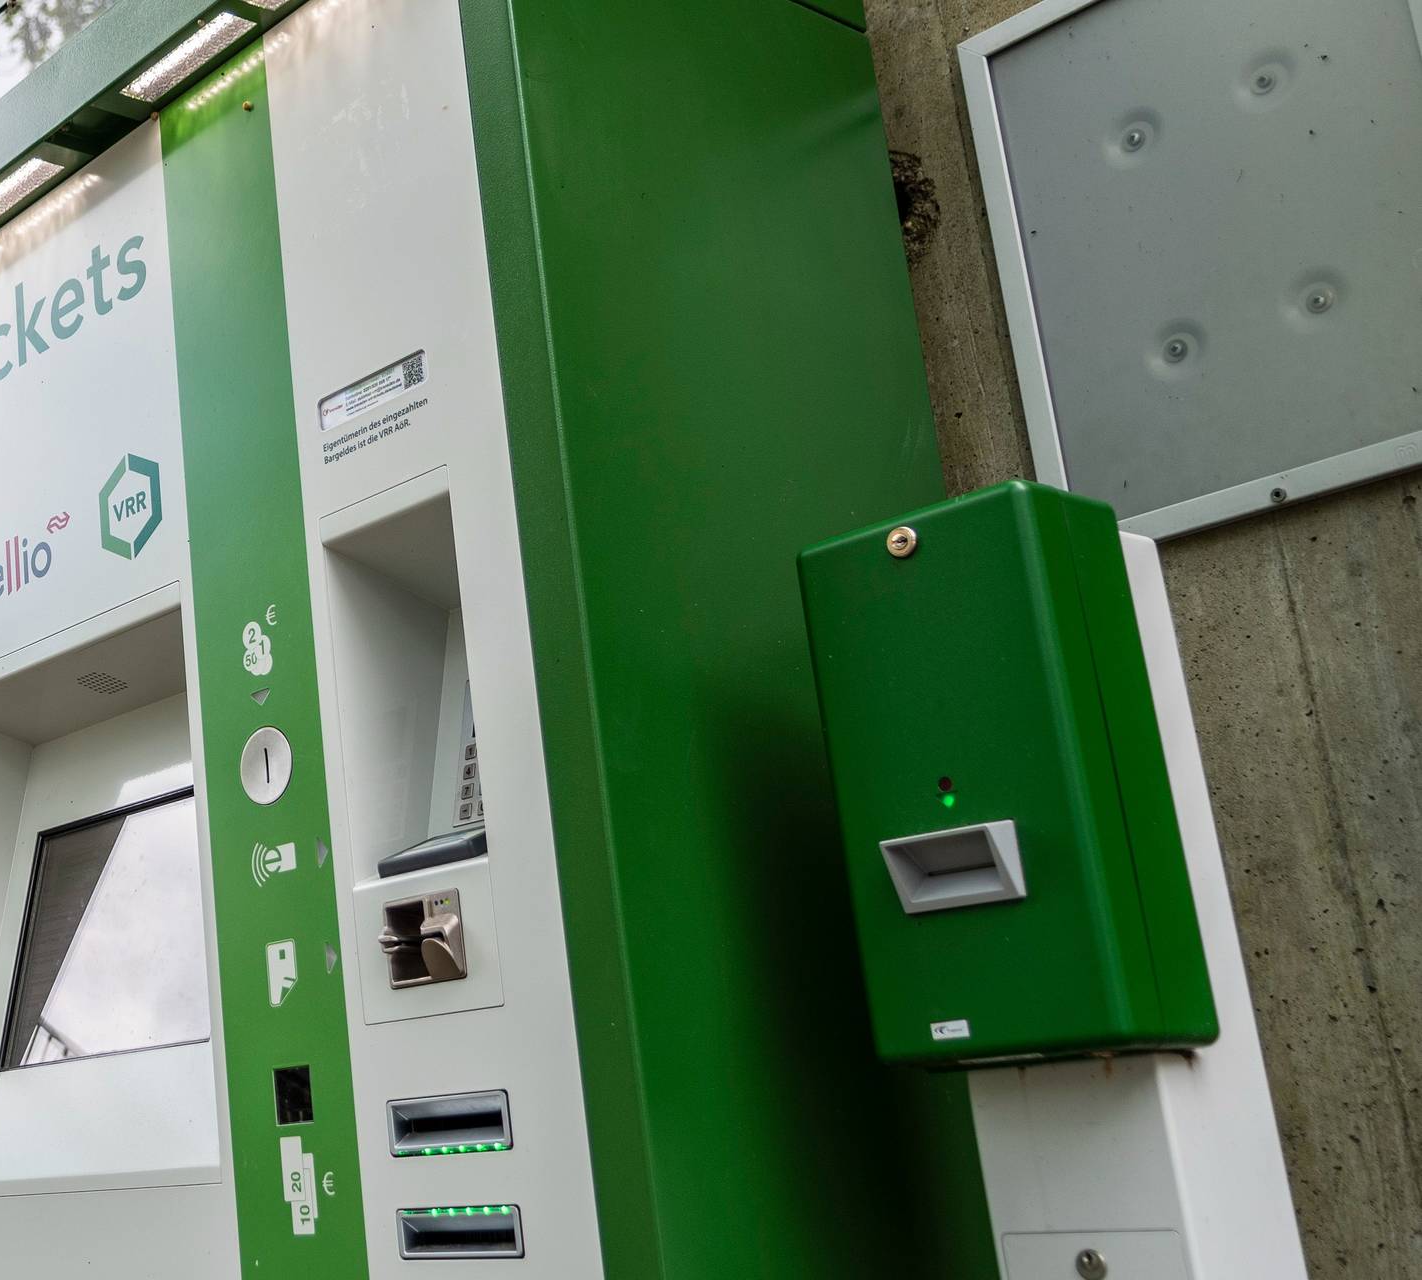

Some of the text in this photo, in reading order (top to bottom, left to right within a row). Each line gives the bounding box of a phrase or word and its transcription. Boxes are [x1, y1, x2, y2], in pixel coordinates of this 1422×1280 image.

[323, 426, 368, 452] Eigentümerin
[369, 419, 382, 431] des
[382, 398, 428, 425] eingezahlten
[324, 418, 411, 464] Bargeldes ist die VRR AöR.
[112, 490, 147, 522] VRR
[266, 604, 278, 625] €
[248, 628, 256, 644] 2
[259, 639, 265, 655] 1
[245, 652, 258, 667] 50
[290, 1171, 302, 1193] 20
[322, 1171, 335, 1195] €
[299, 1204, 311, 1225] 10
